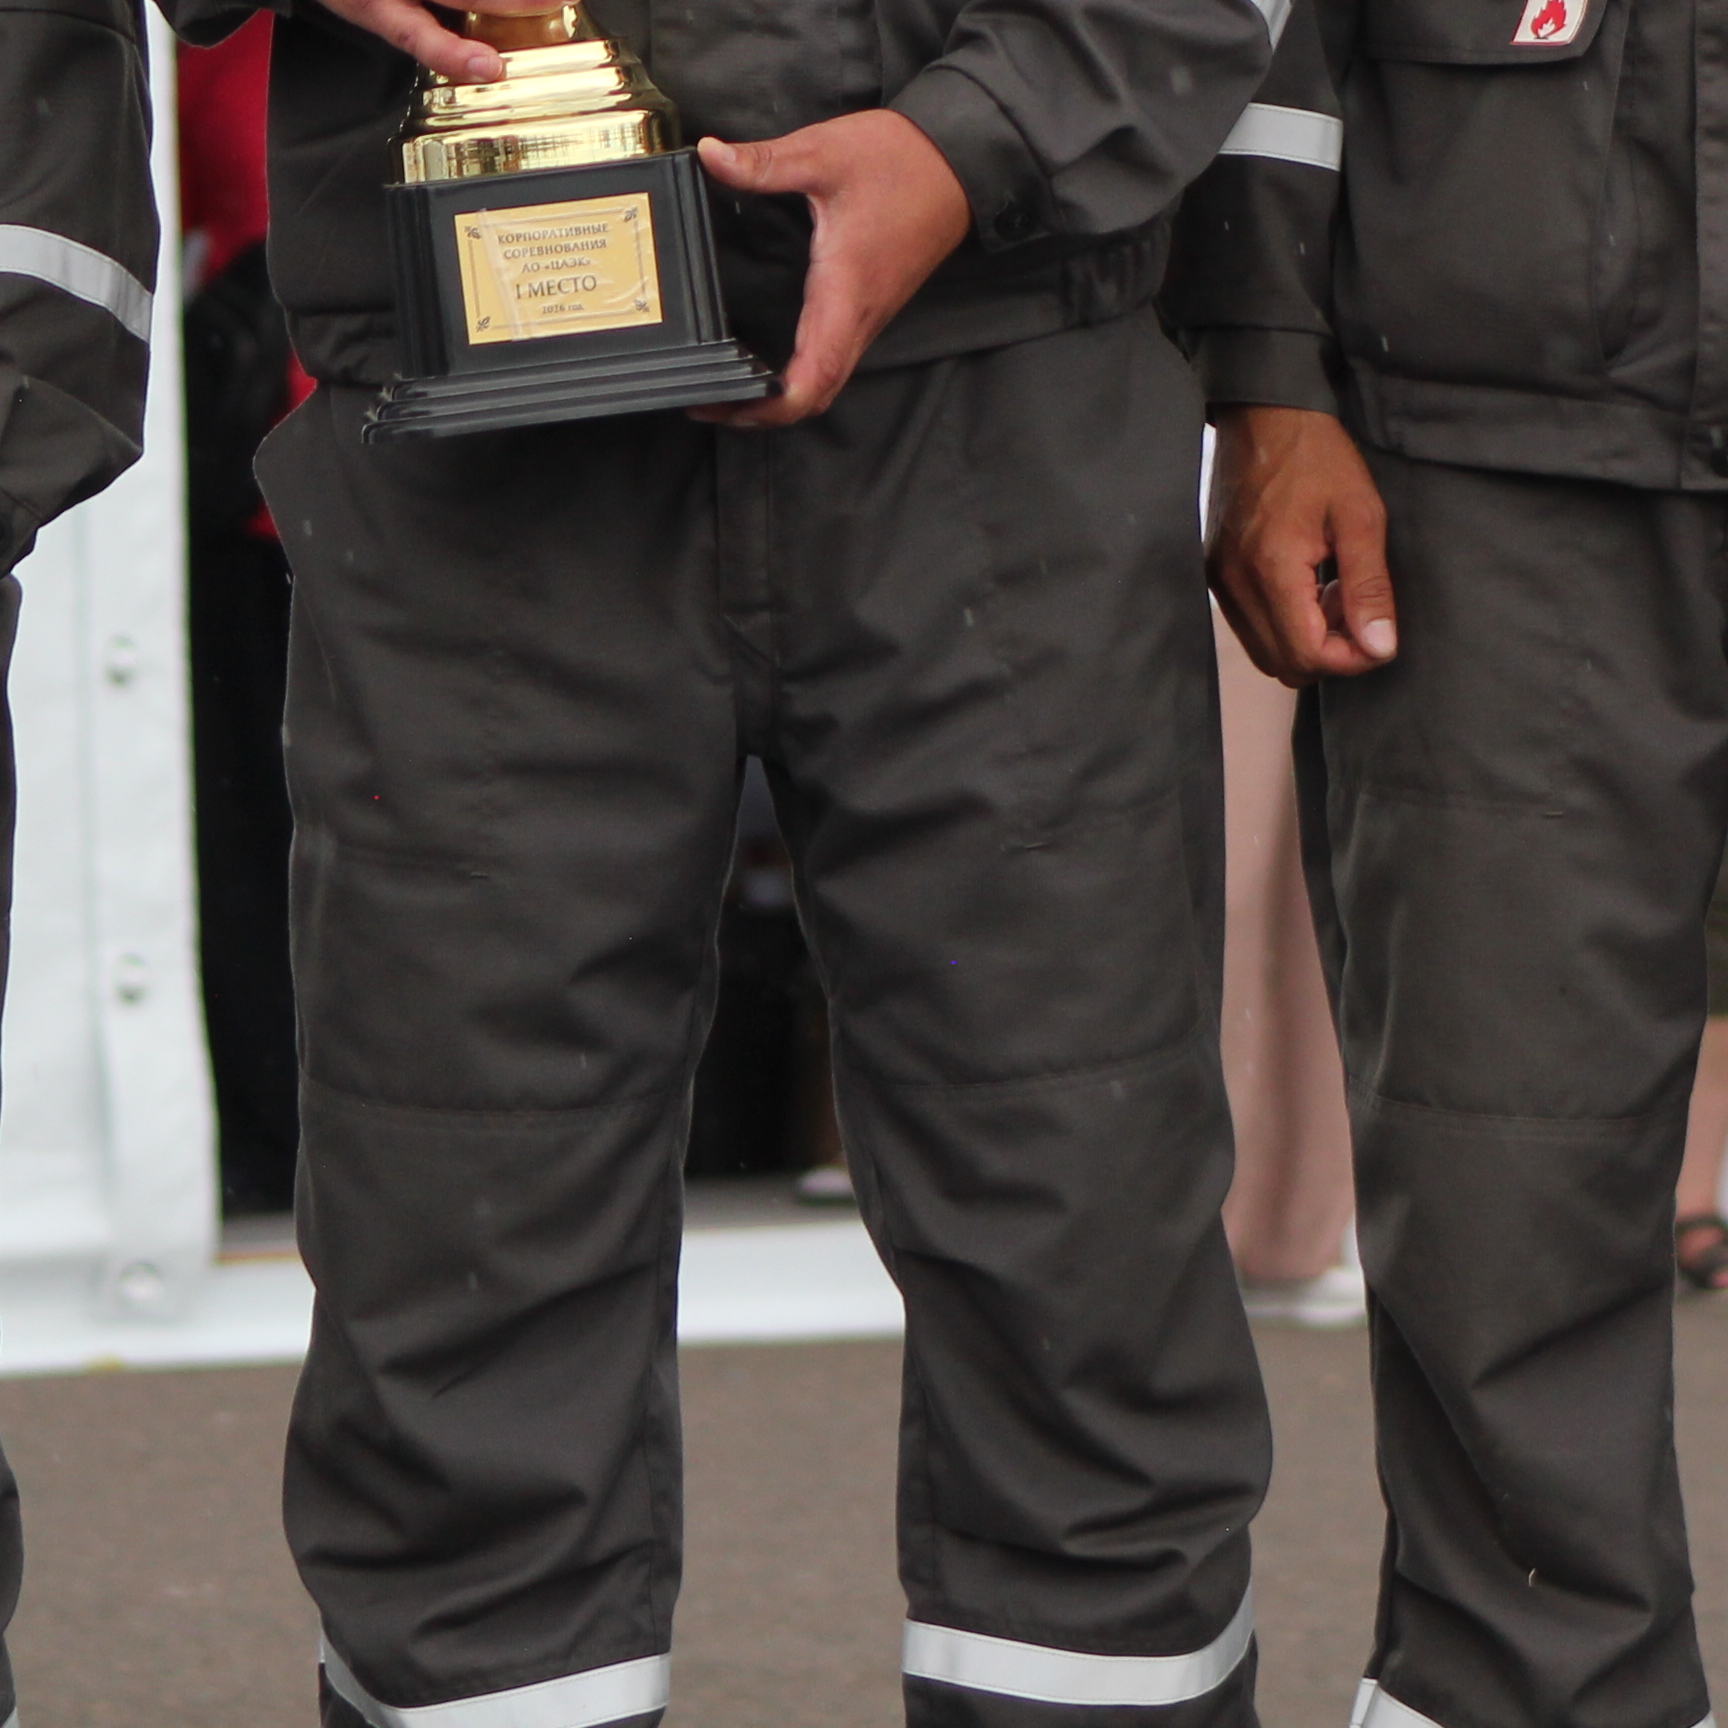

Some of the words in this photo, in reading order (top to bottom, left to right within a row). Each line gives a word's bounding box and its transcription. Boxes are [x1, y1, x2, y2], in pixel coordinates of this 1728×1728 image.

[497, 222, 609, 245] КОРПОРАТИВНЫЕ
[503, 238, 607, 260] СОРЕВНОВАНИЯ
[527, 275, 598, 299] МЕСТО
